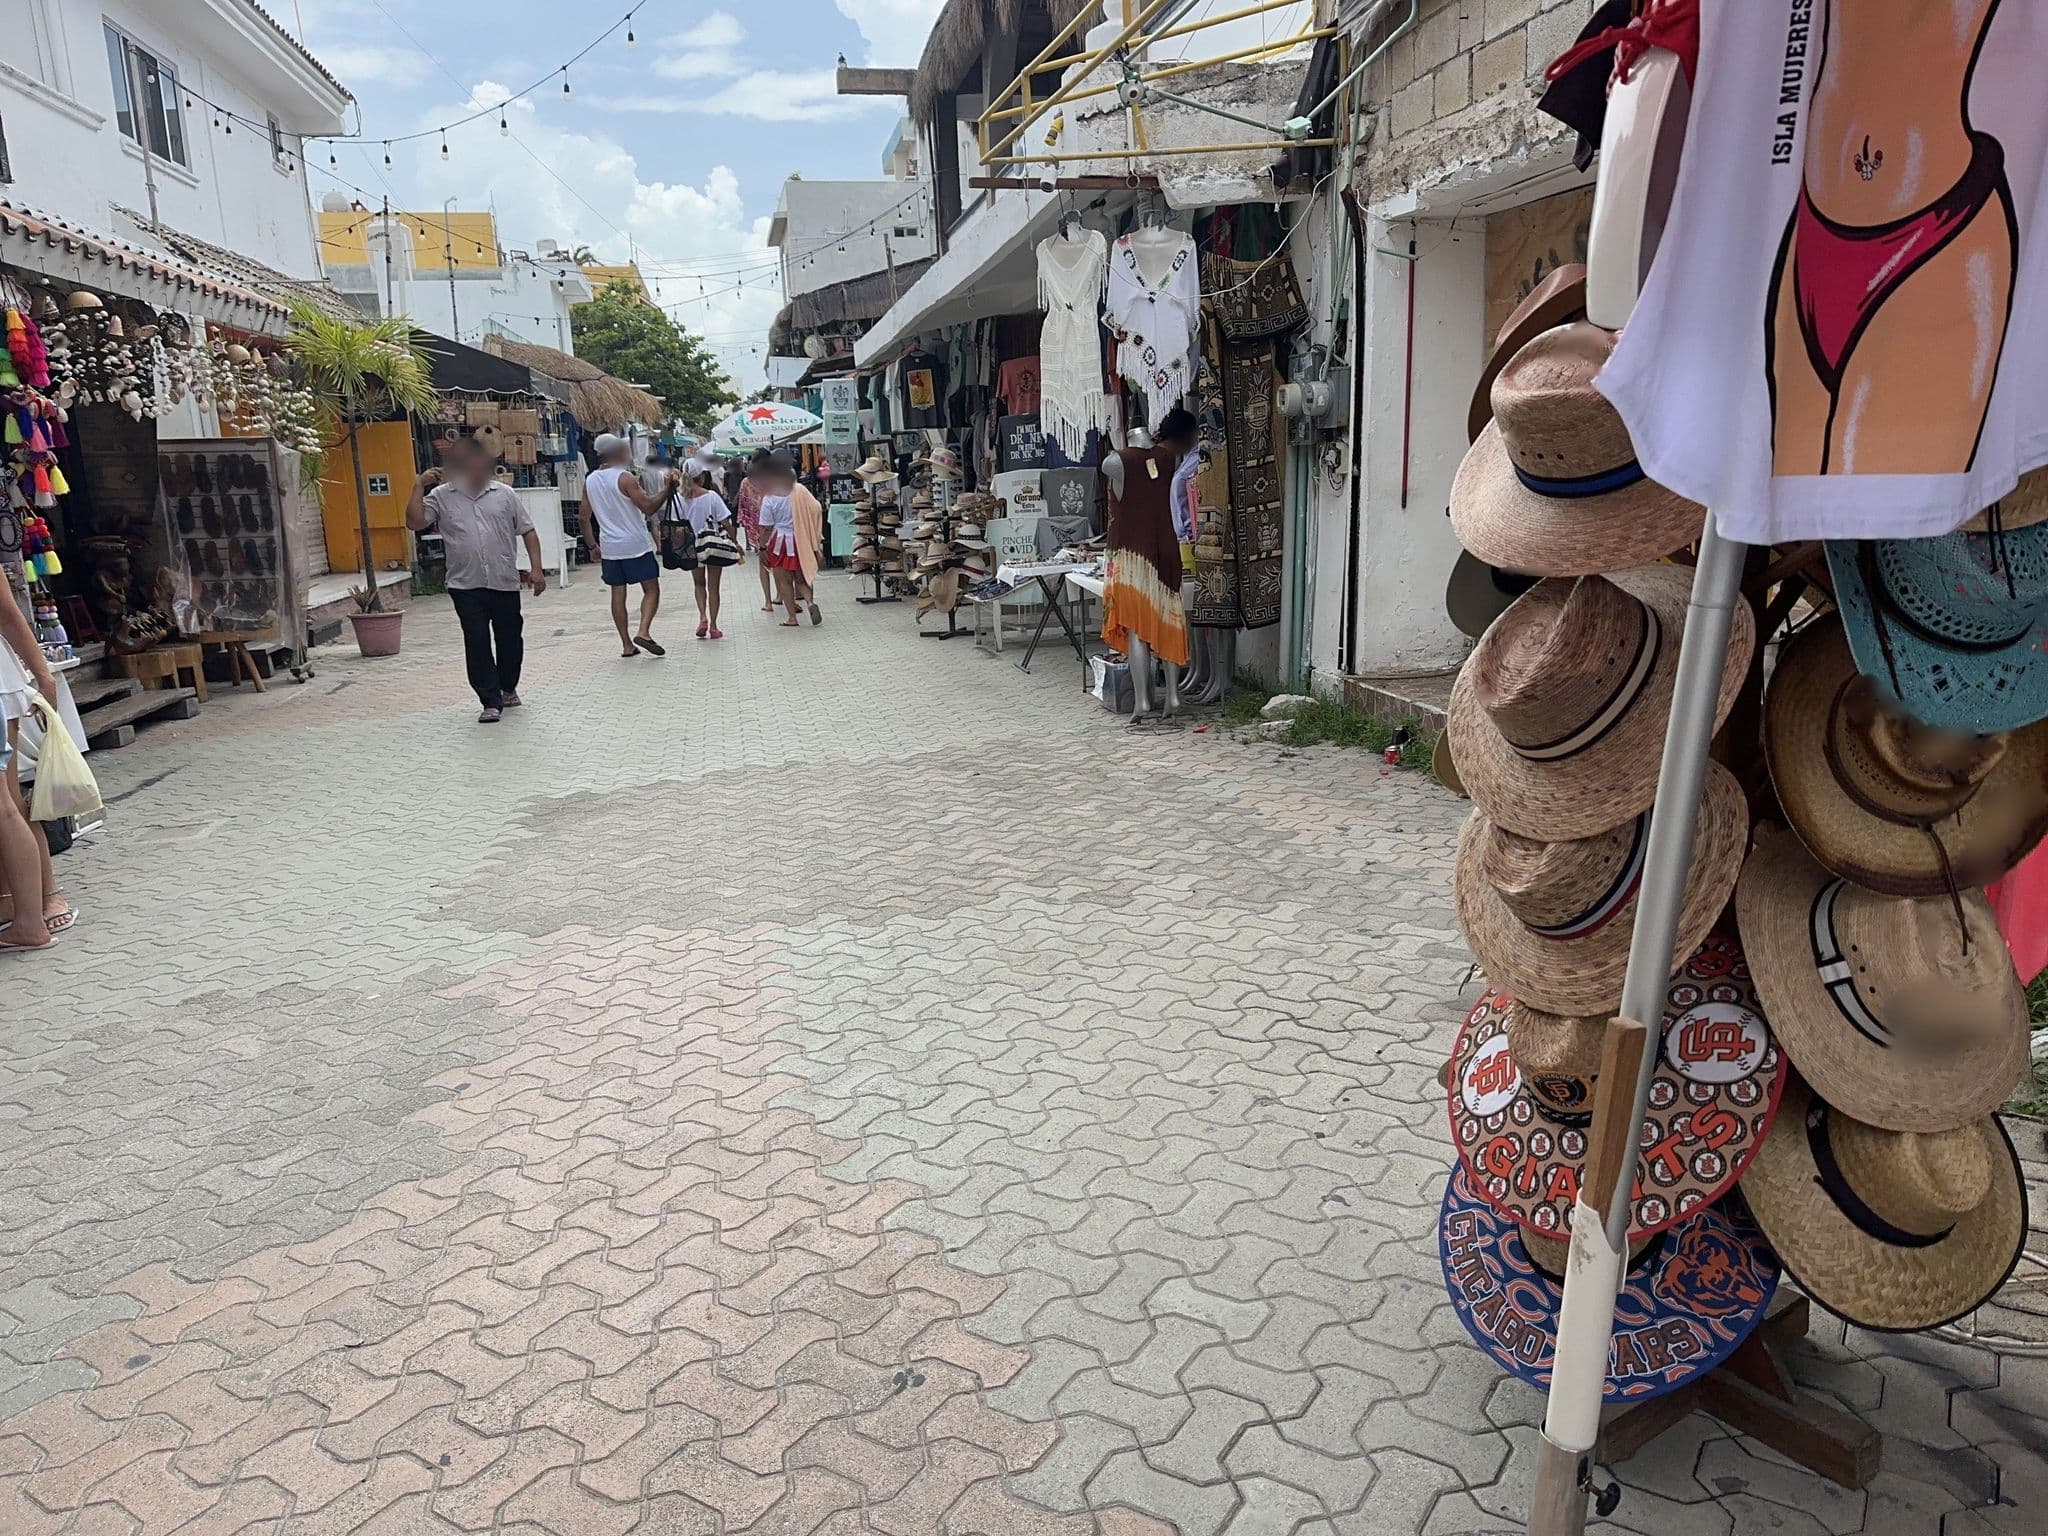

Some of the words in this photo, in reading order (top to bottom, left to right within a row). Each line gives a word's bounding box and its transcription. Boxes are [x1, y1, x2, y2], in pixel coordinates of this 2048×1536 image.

[1780, 0, 1815, 105] MUJERES
[1771, 111, 1798, 166] ISLA
[735, 414, 808, 428] Heineken
[1025, 424, 1036, 433] NOT
[1014, 493, 1042, 505] Corona
[1002, 536, 1033, 545] PINCHE
[1485, 1102, 1739, 1205] GIATS
[1448, 1209, 1548, 1367] CHICAGO
[1605, 1318, 1703, 1378] ARS
